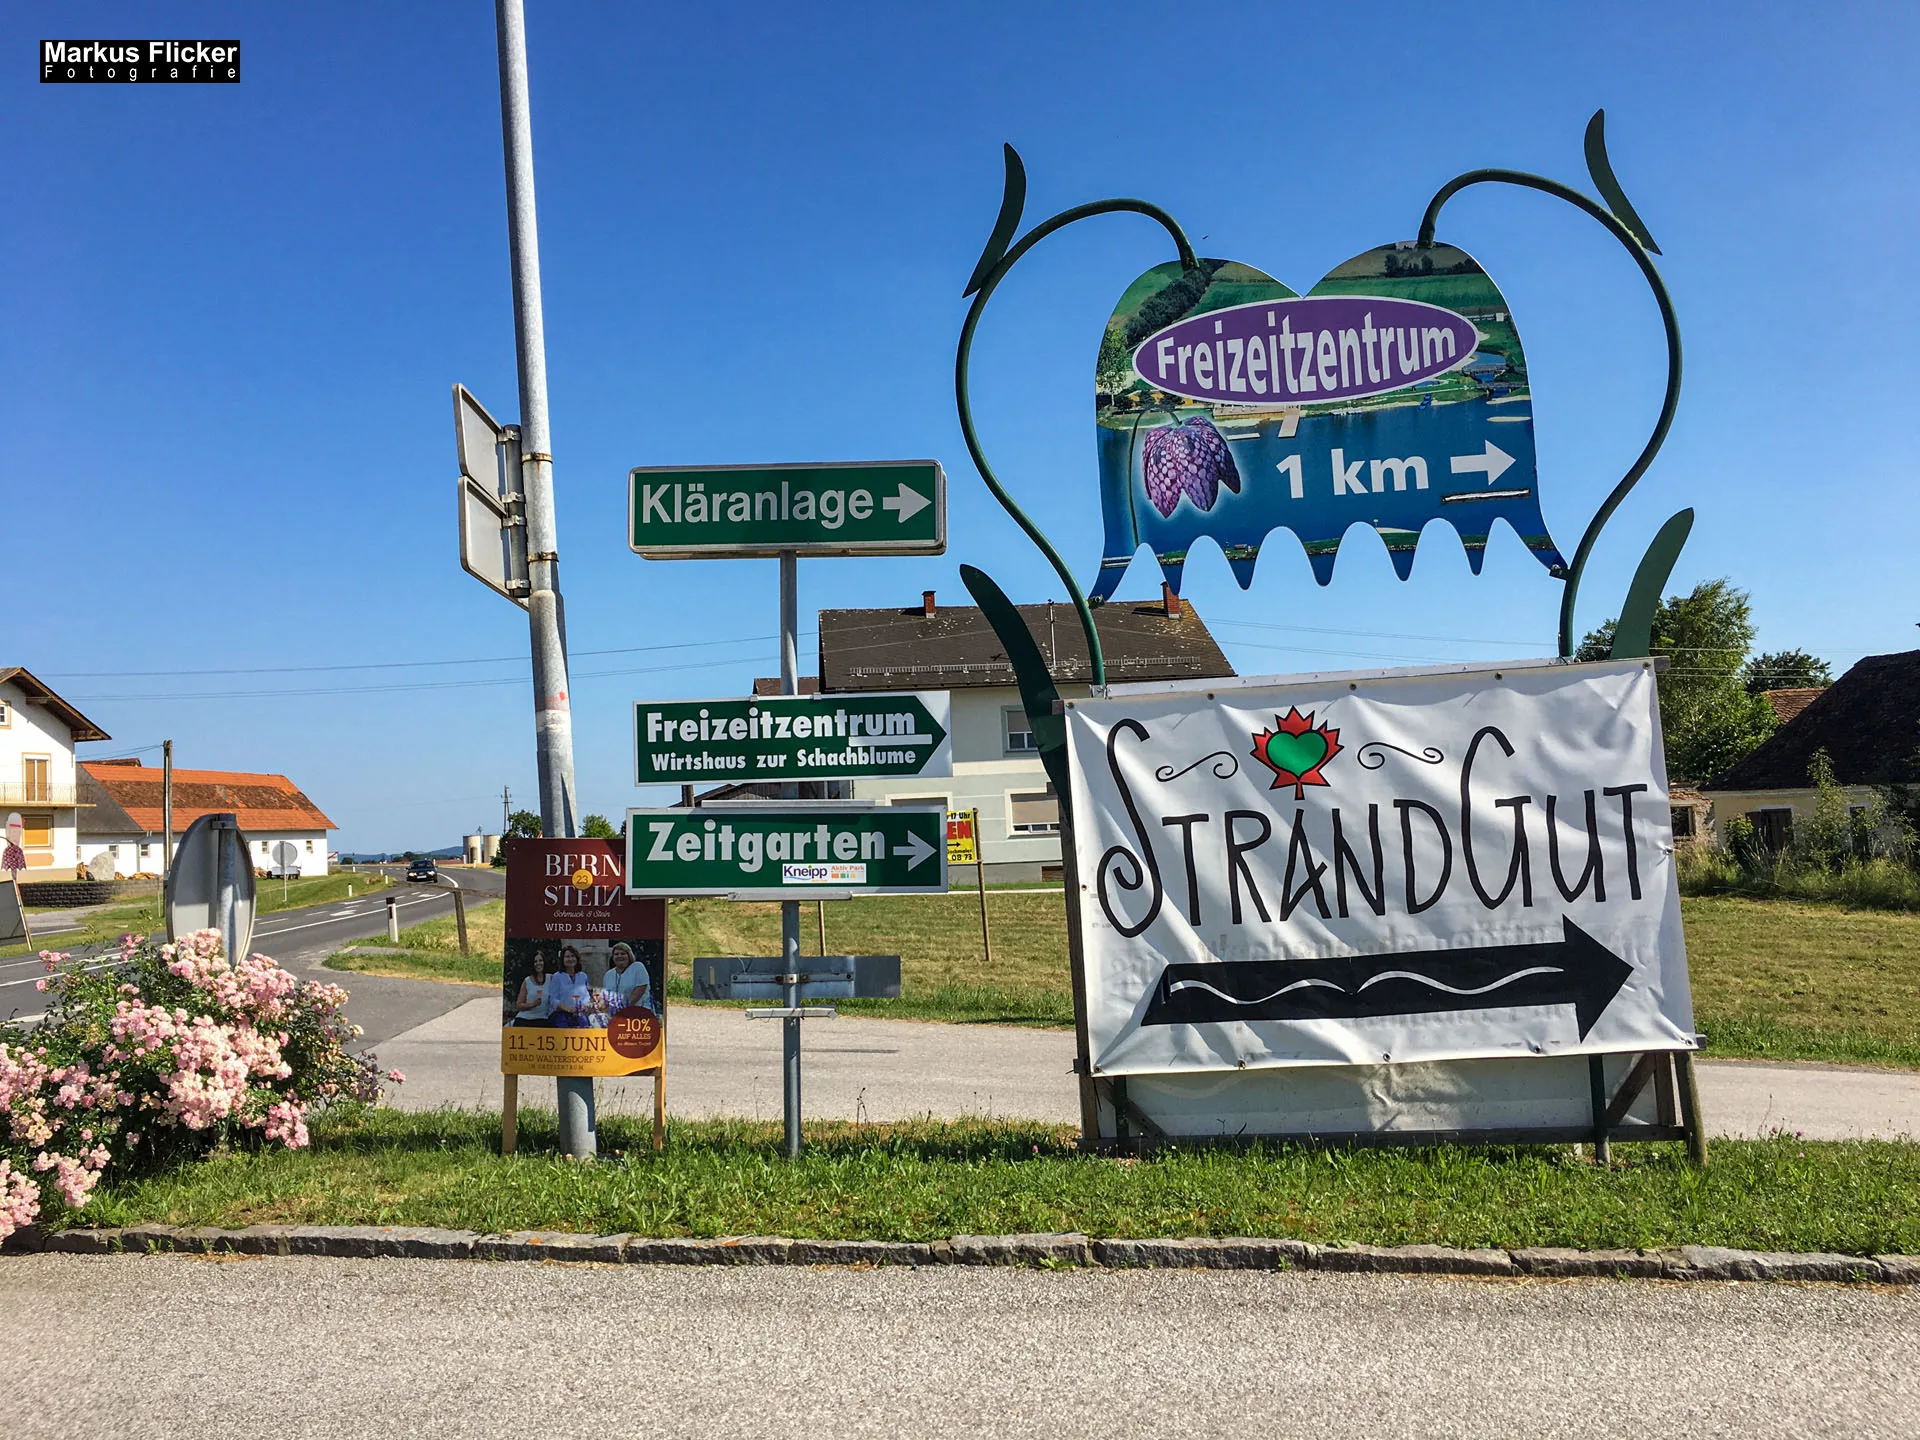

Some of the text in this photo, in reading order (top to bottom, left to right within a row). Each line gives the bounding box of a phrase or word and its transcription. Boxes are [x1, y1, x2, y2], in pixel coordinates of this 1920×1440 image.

[1157, 311, 1456, 394] Freizeitzentrum
[1276, 448, 1429, 499] 1 km
[642, 481, 874, 529] Kläranlage
[647, 707, 915, 742] Freizeitzentrum
[652, 747, 916, 771] Wirtshaus zur Schachblume
[947, 820, 971, 839] EN
[647, 820, 885, 873] Zeitgarten
[545, 854, 624, 877] BERN
[784, 865, 828, 879] Kneipp
[544, 885, 624, 907] STEIN
[553, 909, 584, 918] Schmuck
[593, 909, 611, 918] Stein
[545, 923, 621, 932] WIRD 3 JAHRE
[617, 1018, 651, 1032] -10%
[562, 1036, 607, 1051] JUNI
[509, 1054, 606, 1064] IN BAD WALTERSDORF 57
